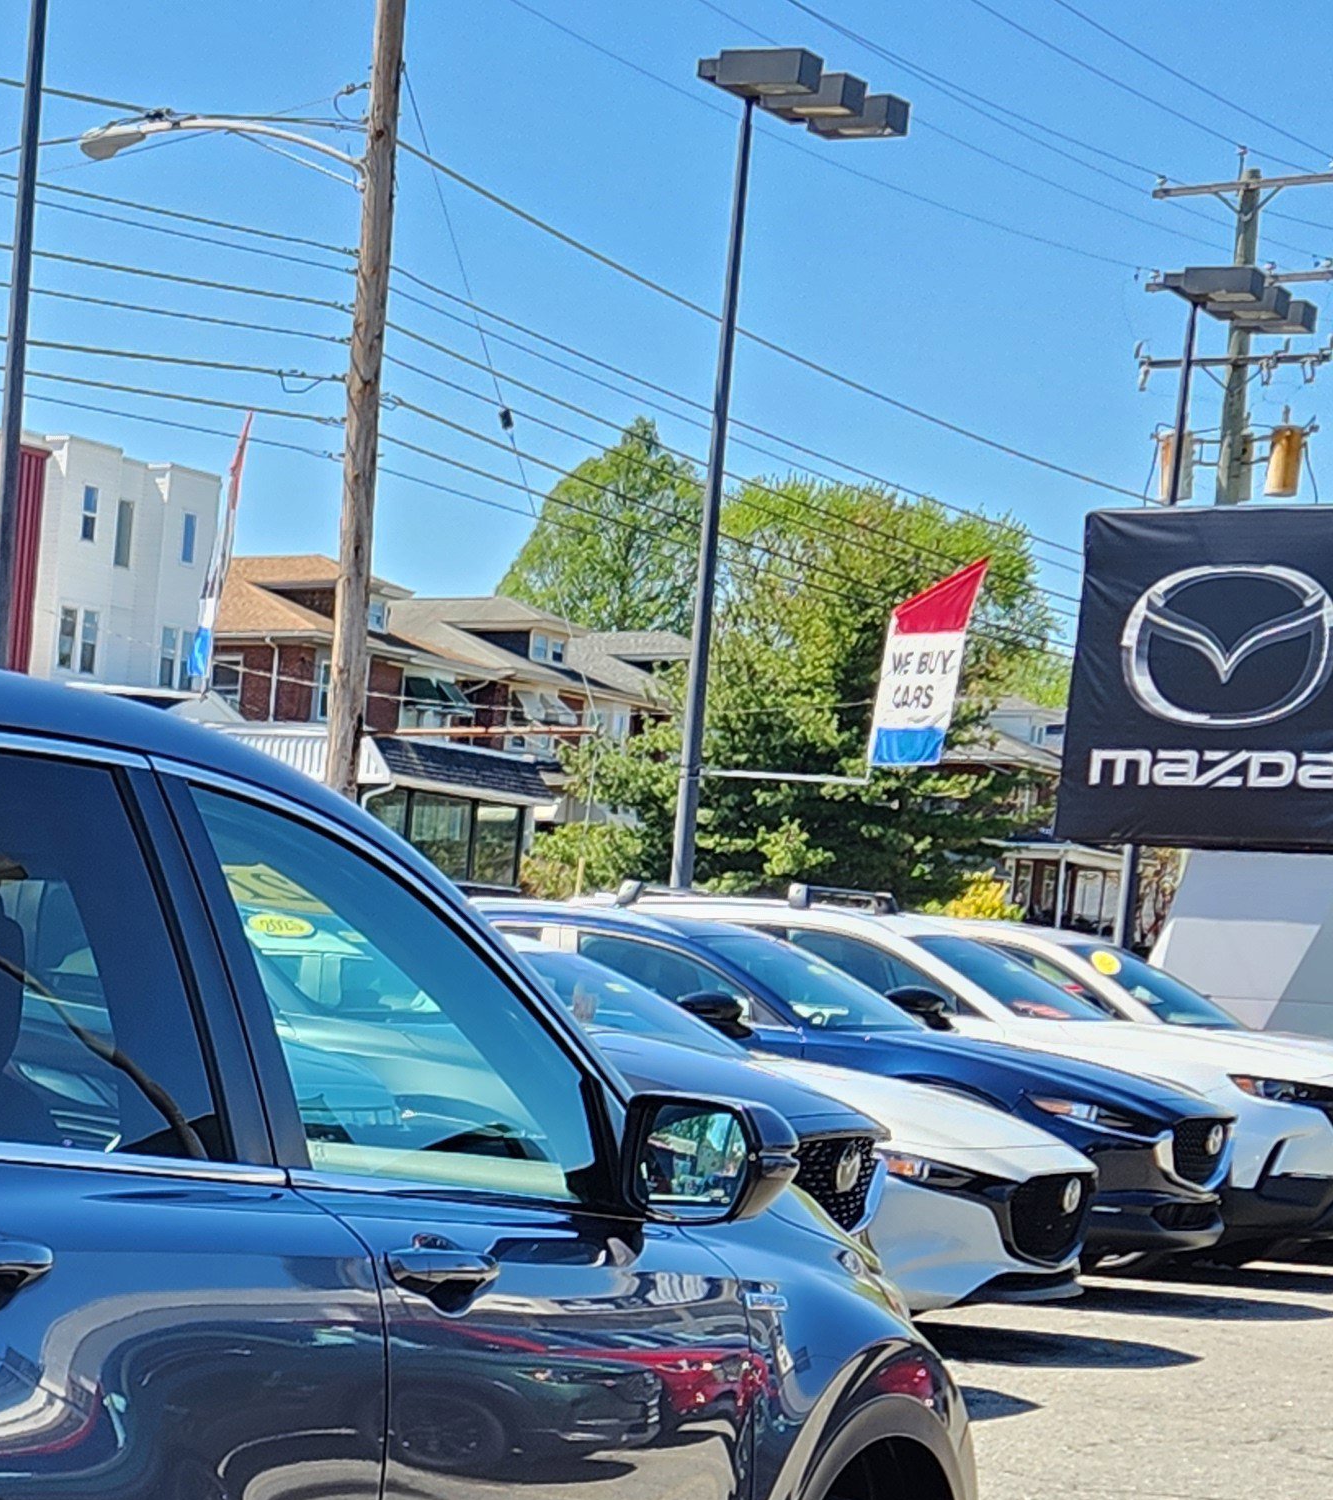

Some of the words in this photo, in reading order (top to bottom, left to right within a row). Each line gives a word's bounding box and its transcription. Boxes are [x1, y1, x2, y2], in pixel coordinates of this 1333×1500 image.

[892, 651, 914, 675] WE
[916, 650, 955, 675] BUY
[892, 684, 934, 709] CARS
